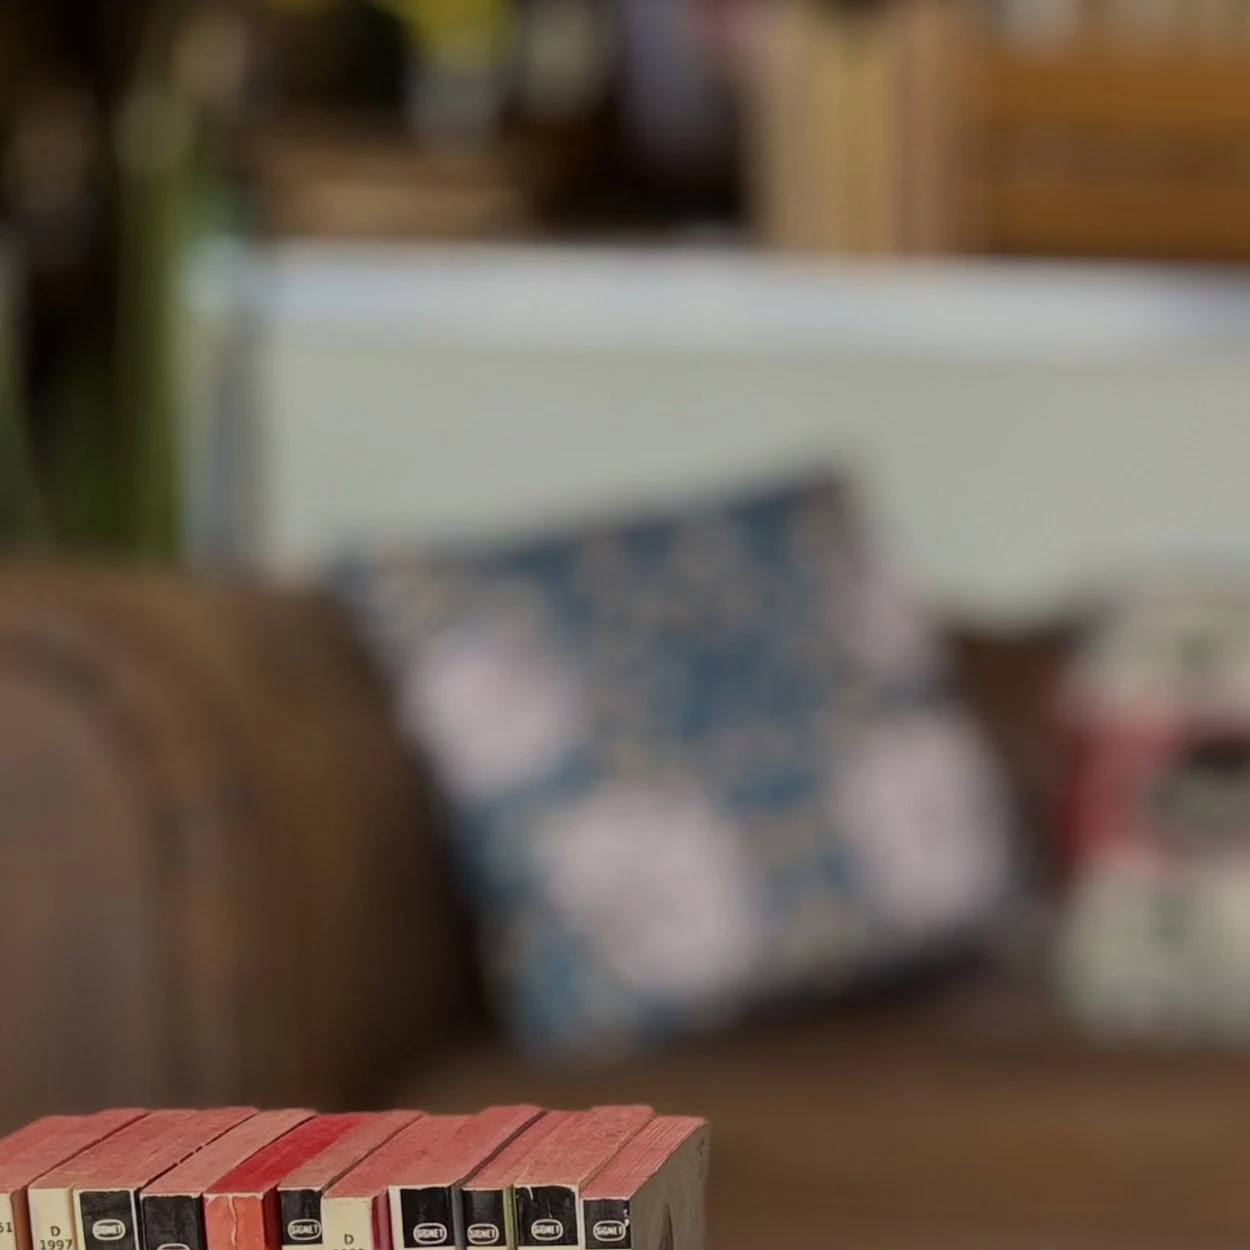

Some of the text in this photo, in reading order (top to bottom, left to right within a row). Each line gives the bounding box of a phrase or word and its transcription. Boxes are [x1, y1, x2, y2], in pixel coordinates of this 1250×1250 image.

[51, 1226, 60, 1237] D
[40, 1239, 73, 1250] 1997
[344, 1234, 354, 1245] D
